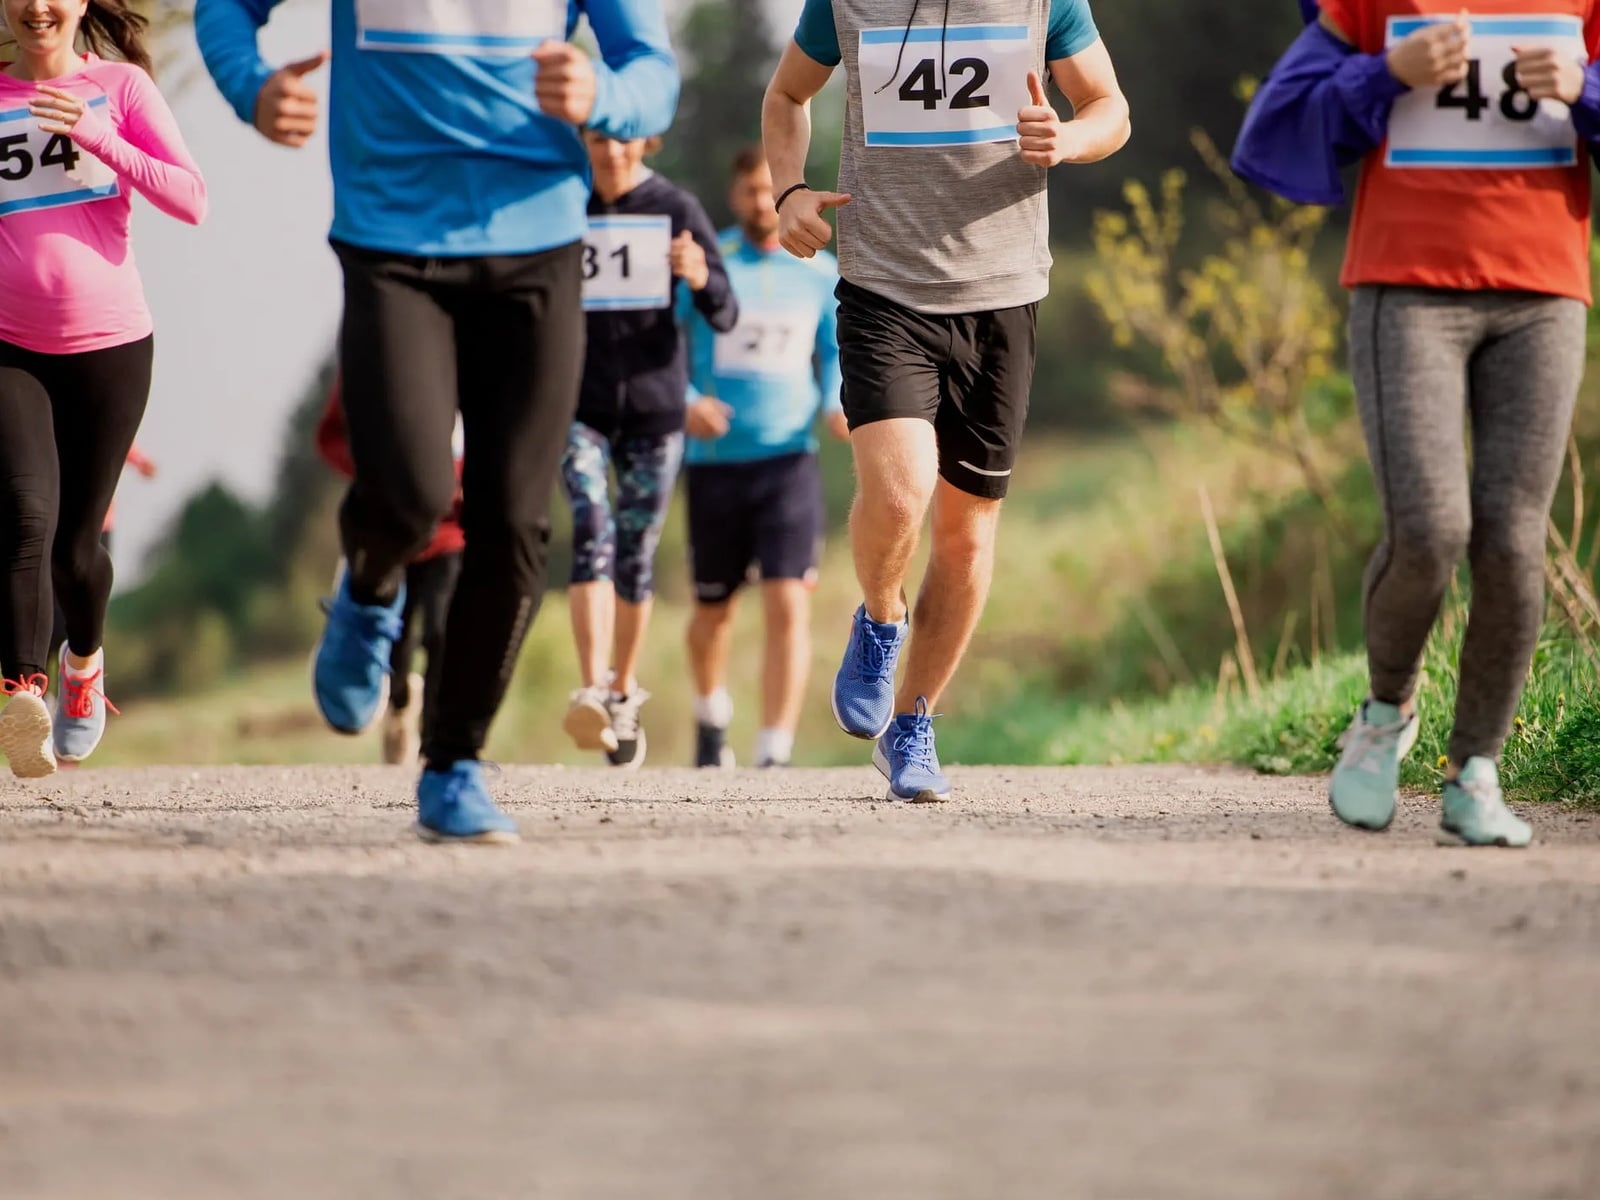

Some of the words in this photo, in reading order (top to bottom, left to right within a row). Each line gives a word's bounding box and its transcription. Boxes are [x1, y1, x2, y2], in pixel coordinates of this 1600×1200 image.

[899, 57, 990, 110] 42
[1435, 59, 1539, 121] 48
[0, 133, 80, 181] 54
